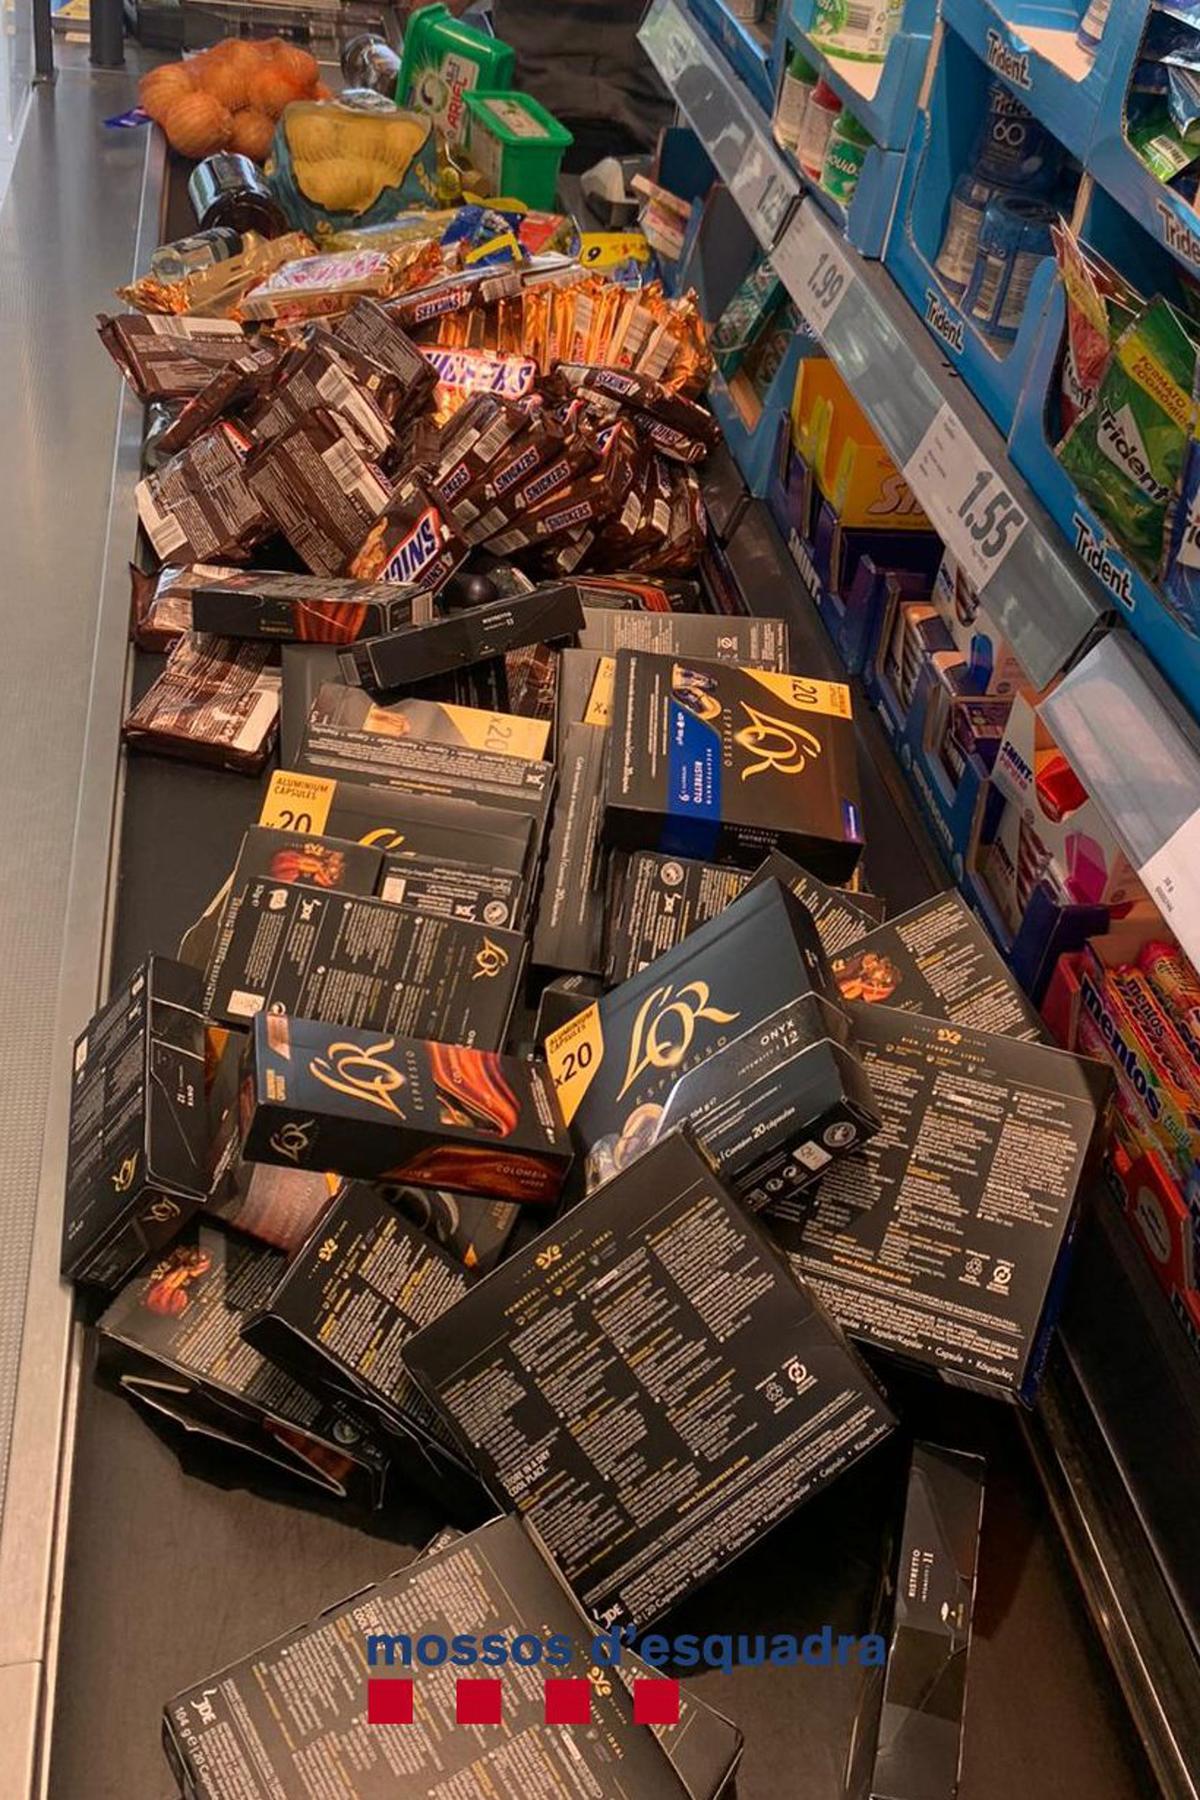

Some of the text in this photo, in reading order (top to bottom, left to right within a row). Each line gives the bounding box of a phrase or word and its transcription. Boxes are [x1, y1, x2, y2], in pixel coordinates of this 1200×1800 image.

[988, 31, 1030, 87] Trident
[447, 79, 468, 128] ARIEL
[993, 122, 1026, 146] 60
[807, 253, 844, 309] 1.99
[926, 290, 964, 351] Trident
[495, 451, 538, 490] SNICKERS
[525, 463, 569, 499] SNICKERS
[958, 471, 1025, 557] 1.55
[1074, 516, 1133, 606] Trident
[718, 708, 735, 767] ESPRESSO
[275, 777, 329, 794] ALUMINIUM
[690, 761, 705, 803] RISTRETTO
[760, 1018, 795, 1047] ONYX
[779, 1029, 801, 1048] 12
[405, 1050, 425, 1111] ESPRESSO
[554, 1042, 594, 1088] x20
[749, 1122, 767, 1139] 20
[495, 1163, 548, 1179] COLOMBIA
[906, 1548, 921, 1597] RISTRETTO
[189, 1695, 216, 1726] JDE
